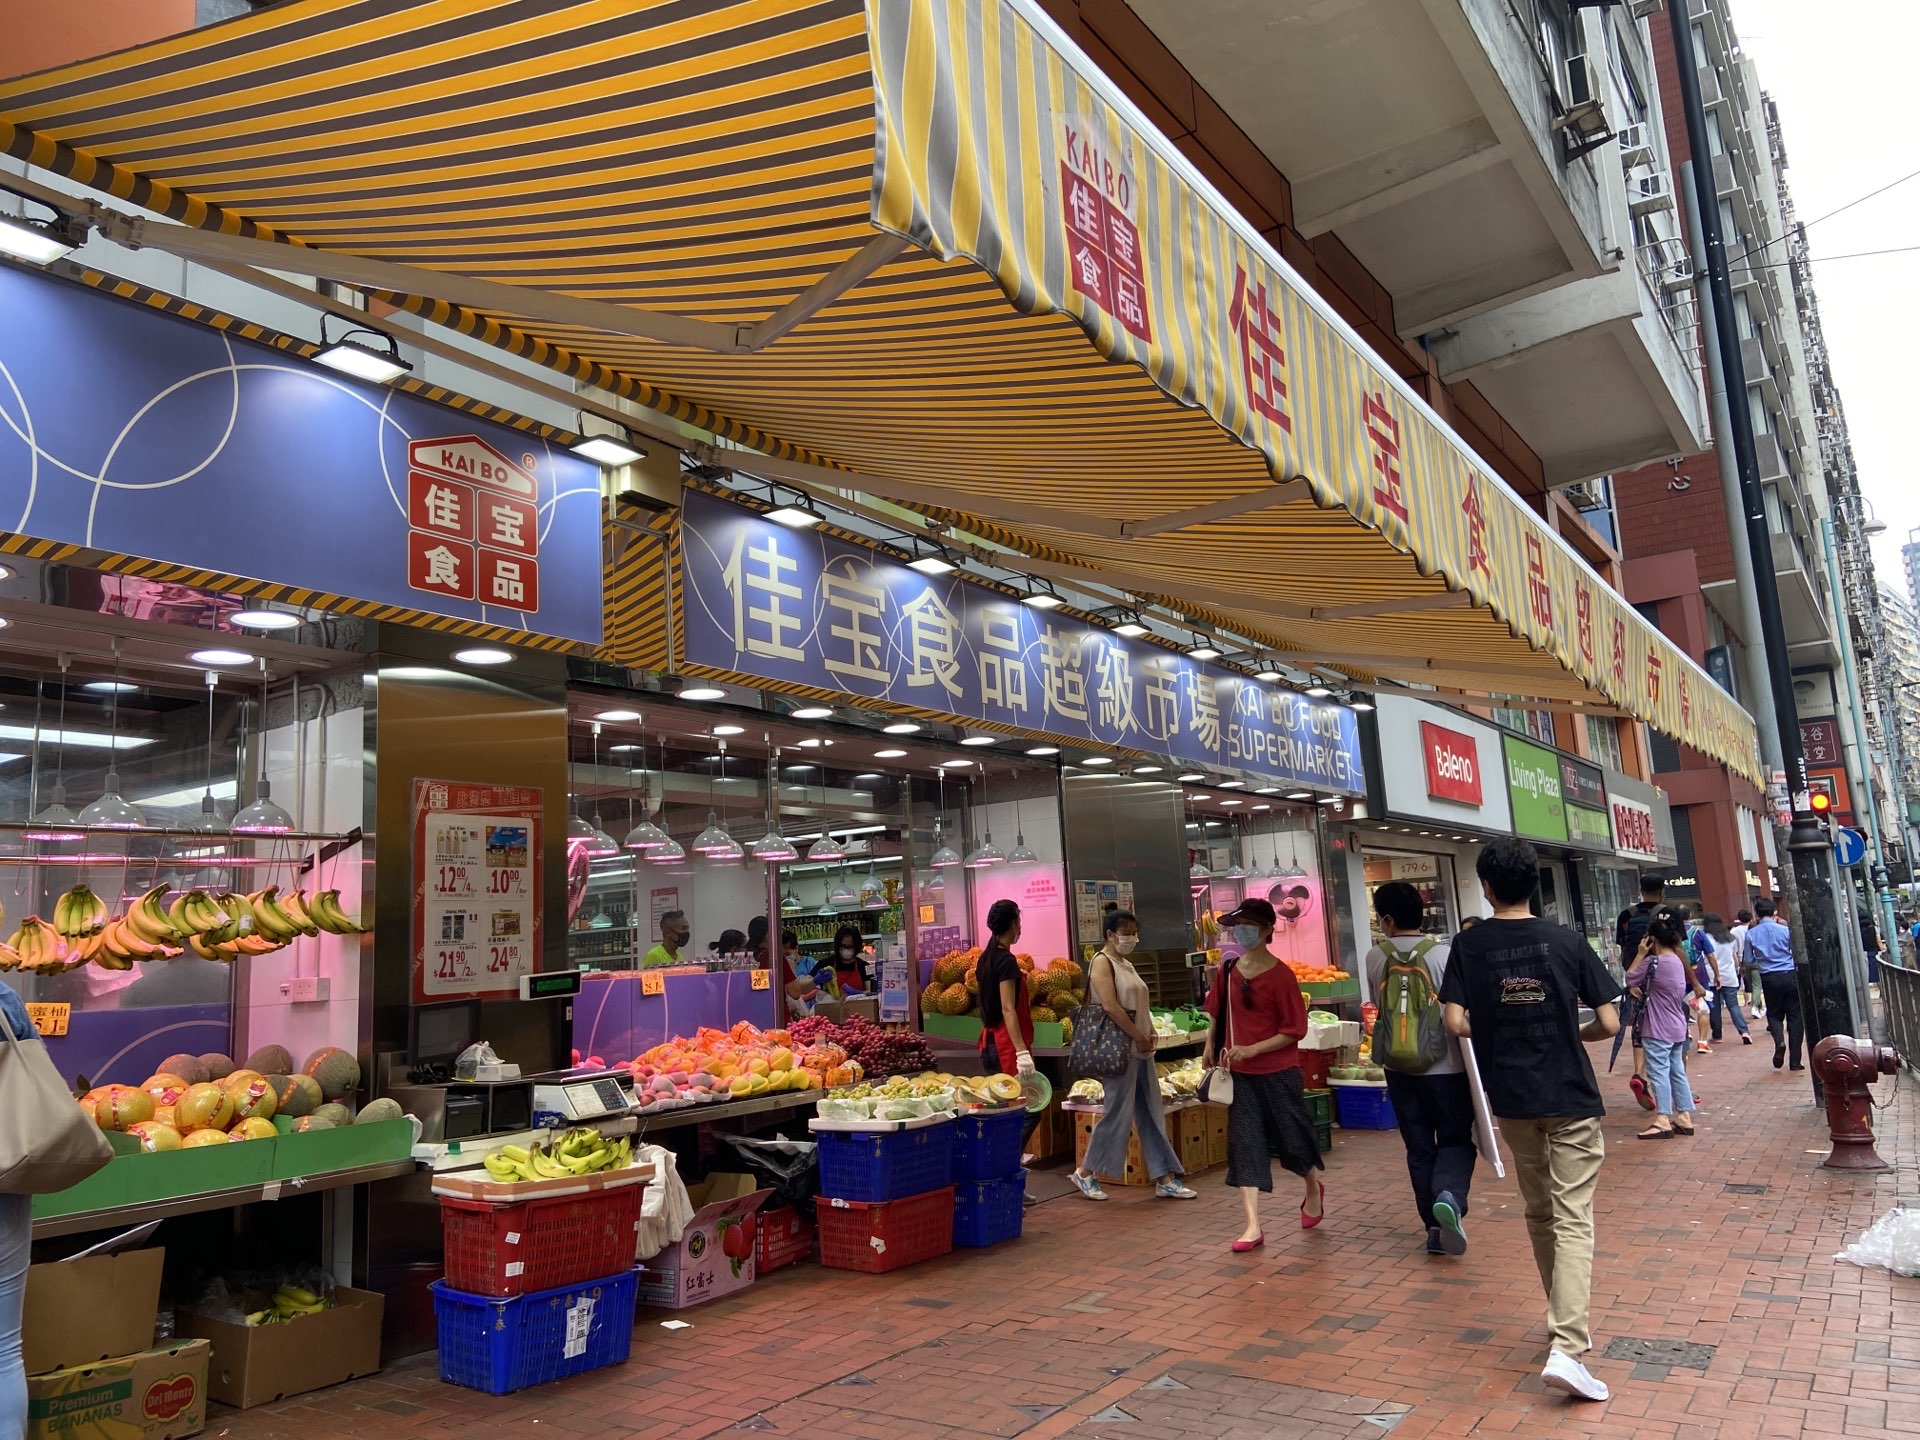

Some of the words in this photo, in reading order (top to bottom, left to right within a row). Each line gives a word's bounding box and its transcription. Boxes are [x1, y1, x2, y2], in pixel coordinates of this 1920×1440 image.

[1065, 124, 1100, 191] KAI
[1103, 157, 1130, 211] BO
[441, 449, 475, 475] KAI
[481, 461, 509, 484] BO
[424, 544, 524, 603] 食品
[1233, 679, 1265, 721] KAI
[1271, 692, 1294, 728] BO
[1299, 701, 1342, 742] FOOD
[1229, 724, 1353, 781] SUPERMARKET
[1435, 745, 1473, 784] Baleno
[1508, 757, 1538, 799] Living
[1537, 767, 1560, 798] Plaza
[1669, 876, 1696, 887] cakes
[49, 1388, 114, 1415] Premium
[147, 1392, 167, 1409] Del
[165, 1382, 193, 1402] Monte
[47, 1402, 123, 1434] BANANAS
